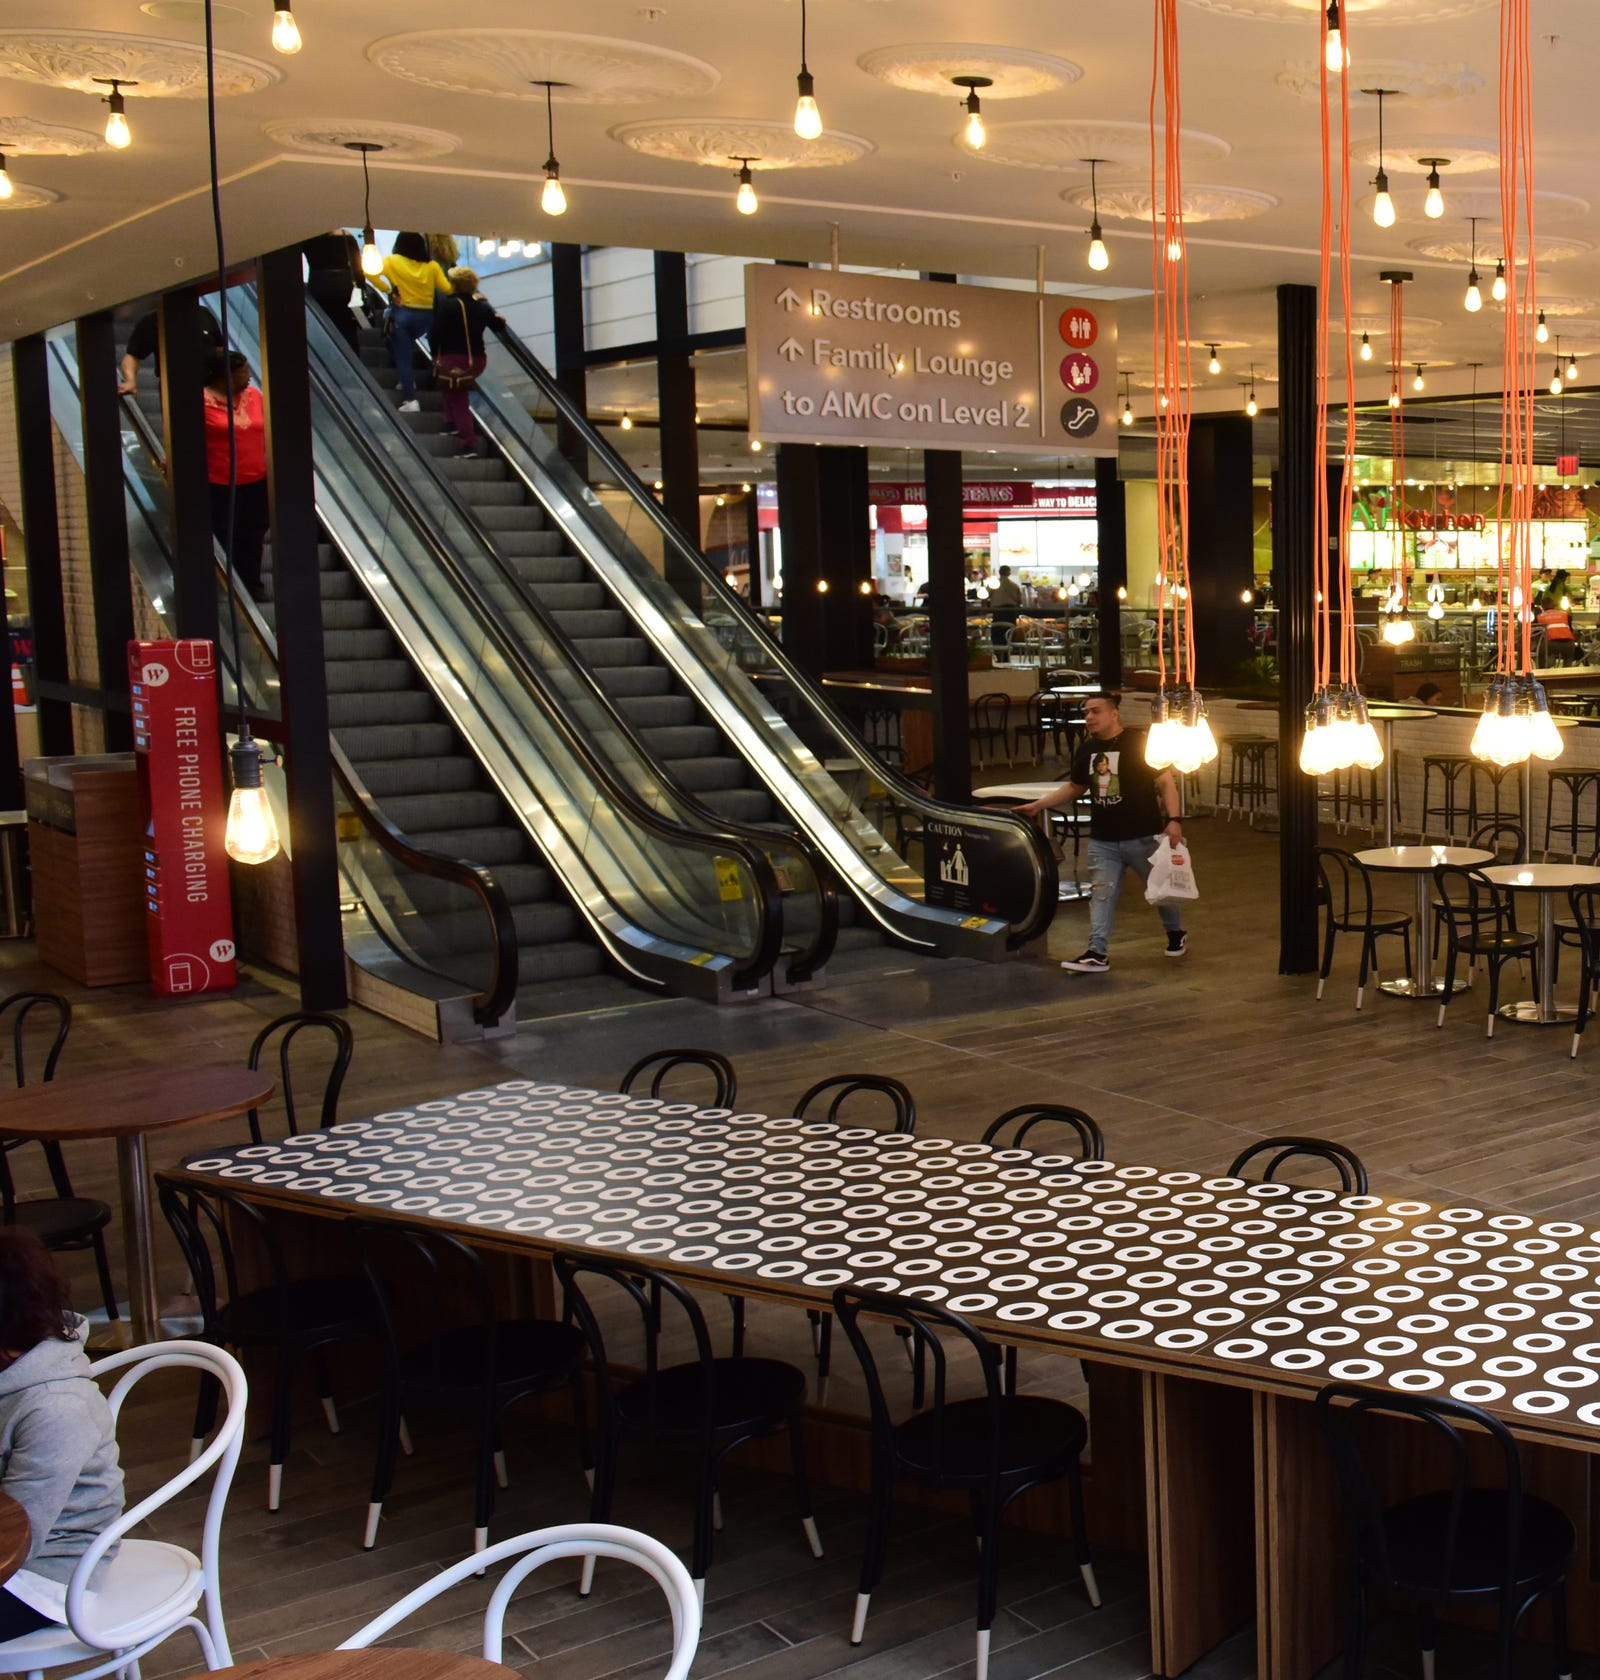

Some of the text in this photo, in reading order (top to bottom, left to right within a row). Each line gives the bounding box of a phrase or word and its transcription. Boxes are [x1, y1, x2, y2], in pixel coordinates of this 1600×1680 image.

[810, 288, 962, 329] Restrooms
[812, 338, 1014, 386] Family Lounge
[782, 390, 1030, 428] to AMC on Level 2
[1037, 497, 1056, 508] WAY
[1055, 497, 1067, 508] TO
[174, 706, 208, 903] FREE PHONE CHARGING
[928, 822, 963, 837] CAUTION
